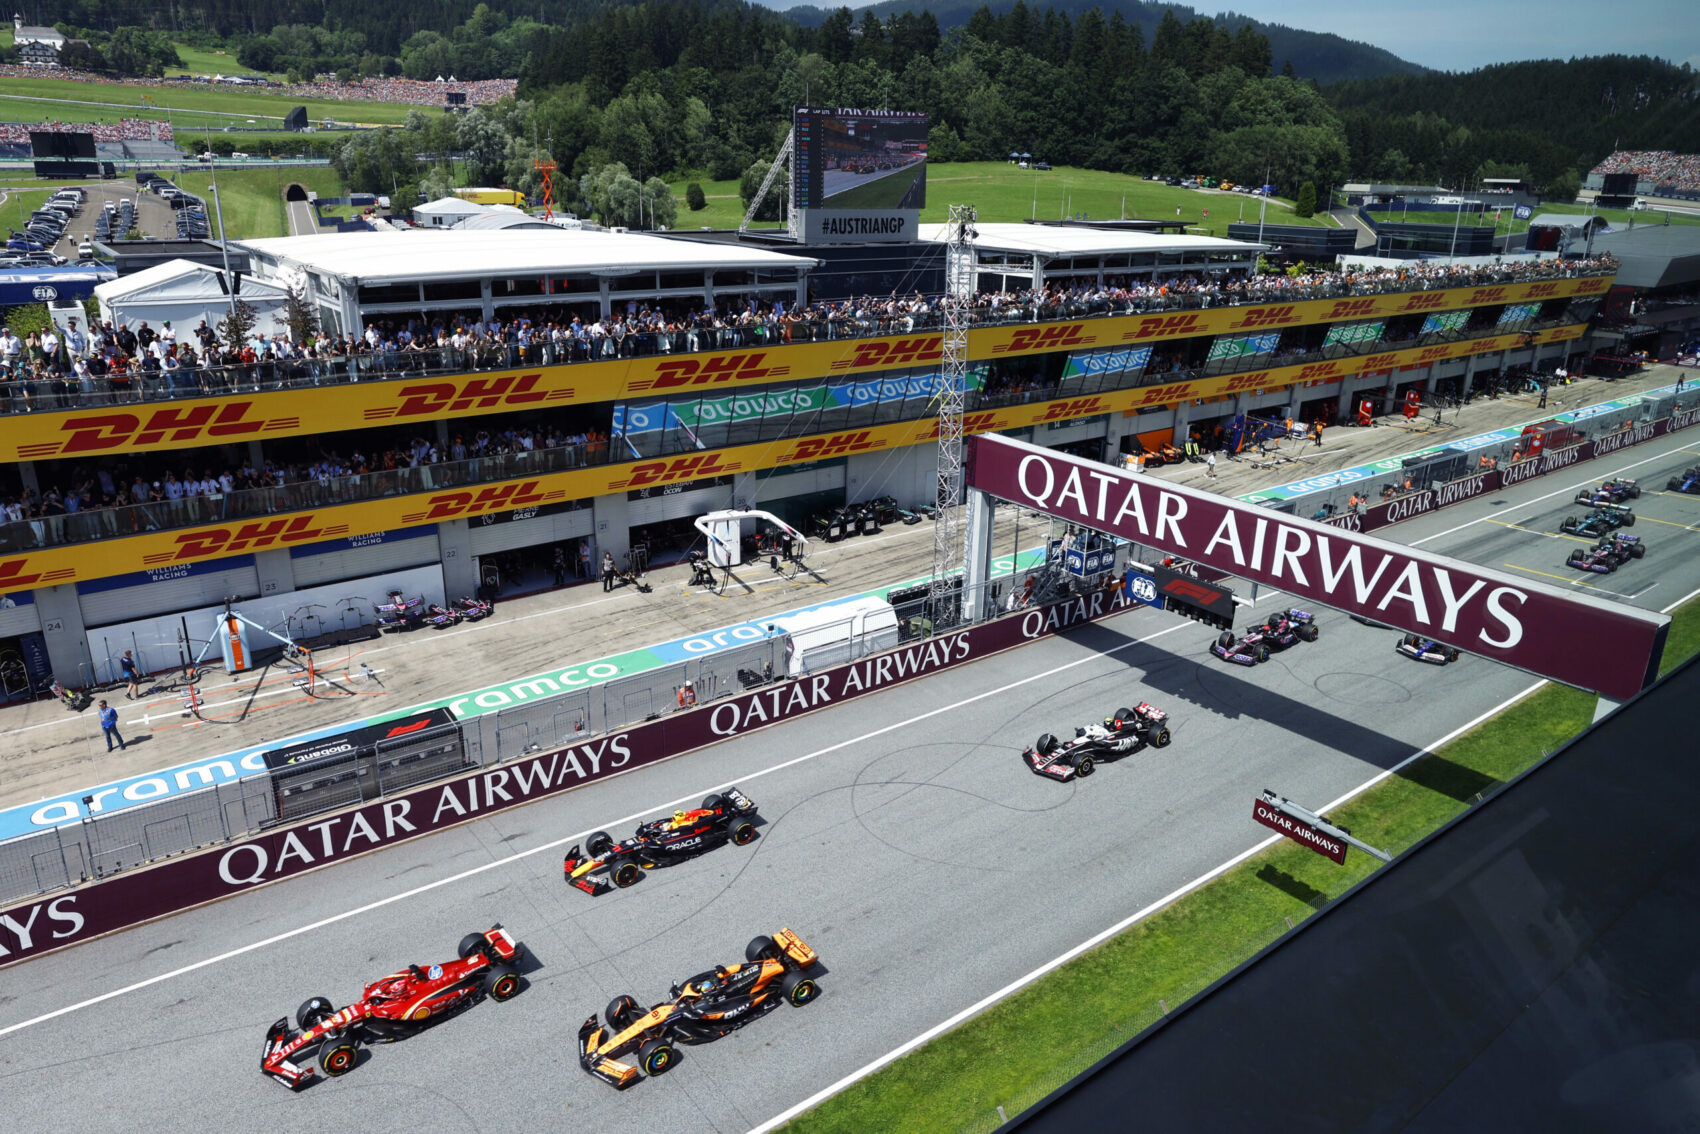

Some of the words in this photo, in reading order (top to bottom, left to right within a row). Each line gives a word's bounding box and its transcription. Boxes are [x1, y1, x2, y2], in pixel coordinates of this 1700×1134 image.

[822, 217, 905, 234] #AUSTRIANGP
[34, 288, 55, 298] FIA
[1404, 293, 1445, 312] DHL
[1239, 305, 1295, 327] DHL
[1328, 299, 1377, 318] DHL
[1134, 314, 1200, 338] DHL
[1007, 325, 1086, 351] DHL
[851, 337, 944, 367] DHL
[1363, 353, 1397, 369] DHL
[652, 353, 770, 389] DHL
[1225, 372, 1269, 391] DHL
[1299, 362, 1338, 379] DHL
[396, 374, 549, 416] DHL
[1141, 384, 1191, 404] DHL
[1045, 397, 1102, 419] DHL
[62, 401, 264, 453] DHL
[792, 431, 871, 460] DHL
[1593, 434, 1622, 457] QATAR
[1623, 423, 1656, 448] AIRWAYS
[628, 454, 724, 487] DHL
[1502, 459, 1537, 485] QATAR
[1538, 447, 1578, 475] AIRWAYS
[663, 486, 682, 495] OCON
[1287, 471, 1363, 492] aramco
[427, 481, 547, 519] DHL
[1386, 492, 1431, 523] QATAR
[1433, 475, 1484, 508] AIRWAYS
[512, 511, 537, 521] GASLY
[175, 516, 323, 559] DHL
[347, 531, 386, 541] WILLIAMS
[352, 537, 382, 548] RACING
[1017, 453, 1188, 549] QATAR
[1204, 510, 1528, 650] AIRWAYS
[146, 562, 192, 575] WILLIAMS
[152, 570, 188, 581] RACING
[1022, 592, 1103, 638] QATAR
[710, 674, 831, 736] QATAR
[842, 631, 970, 696] AIRWAYS
[299, 744, 352, 763] Globant
[218, 798, 416, 884] QATAR
[433, 733, 632, 823] AIRWAYS
[1257, 807, 1292, 831] QATAR
[1293, 826, 1340, 854] AIRWAYS
[665, 836, 702, 851] ORACLE
